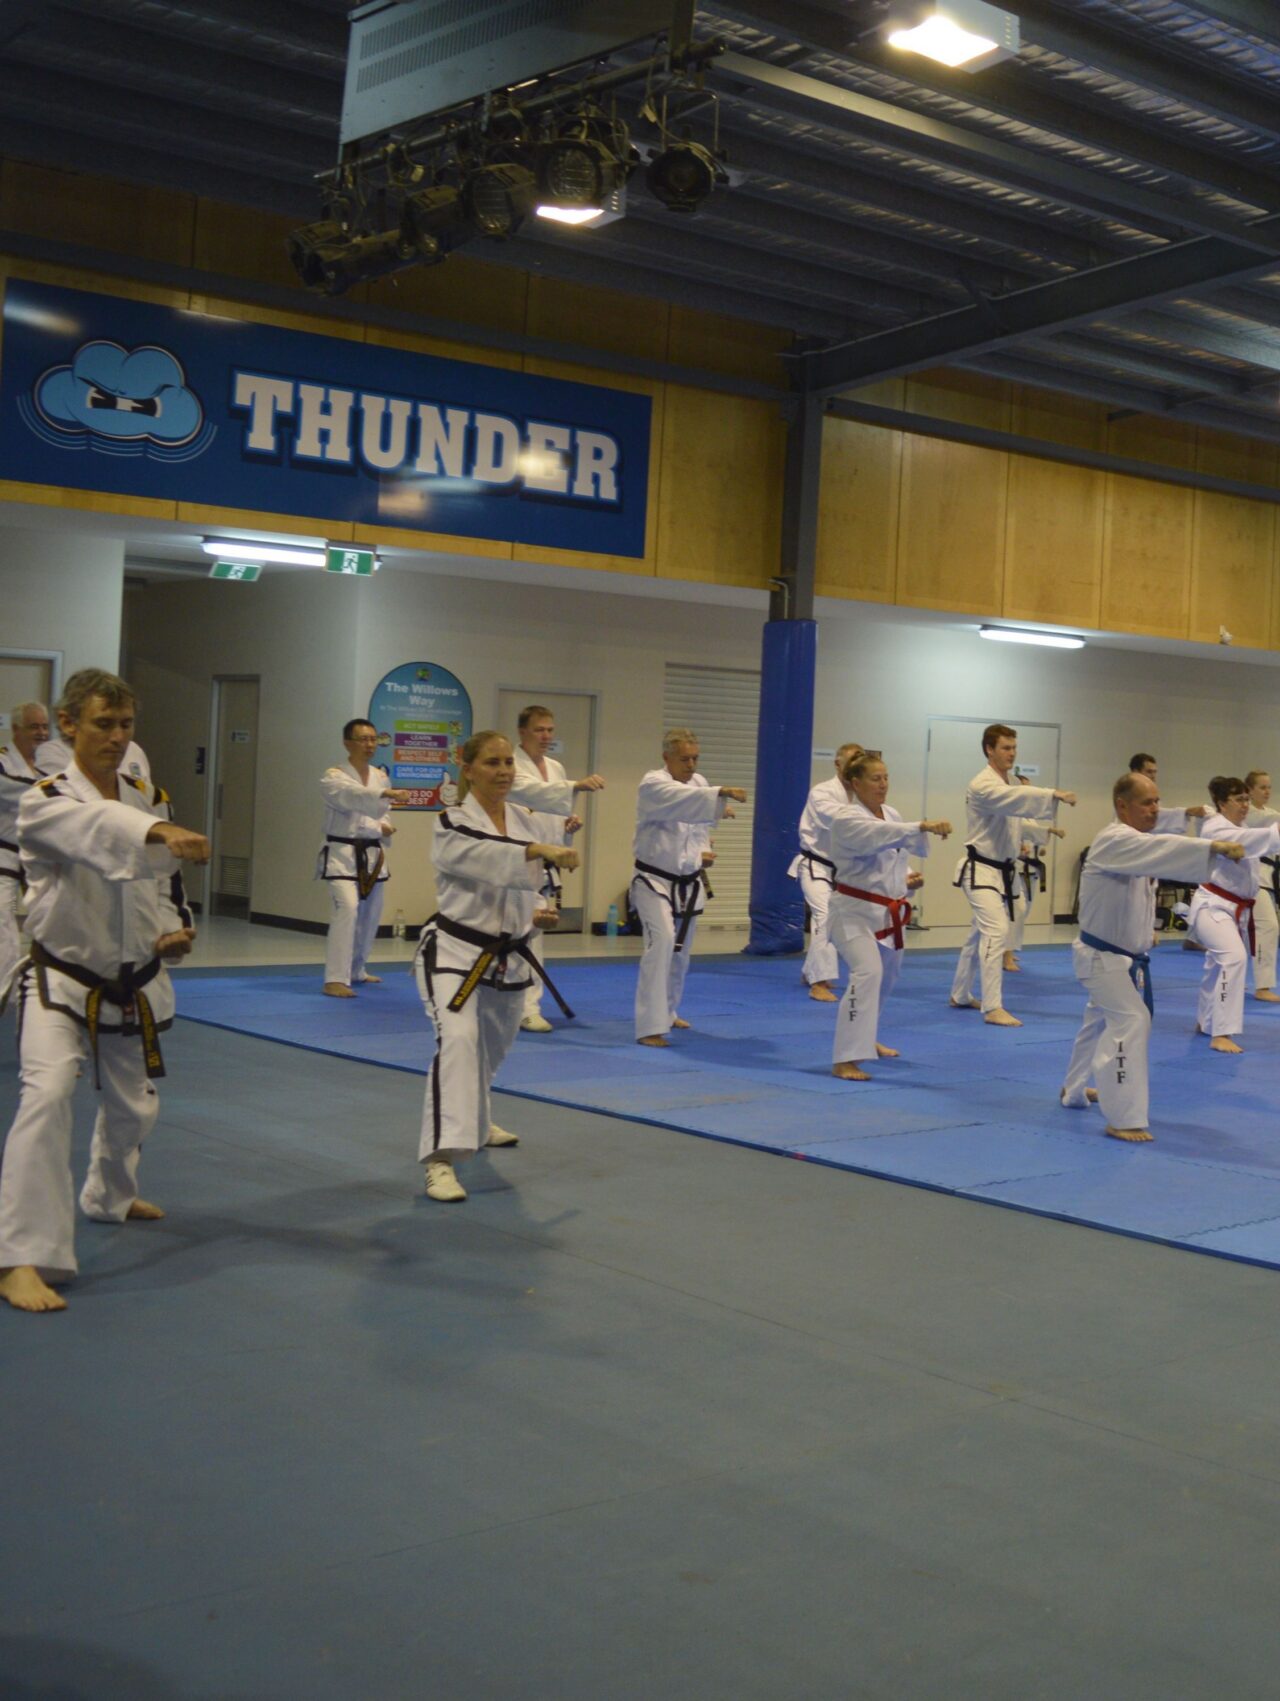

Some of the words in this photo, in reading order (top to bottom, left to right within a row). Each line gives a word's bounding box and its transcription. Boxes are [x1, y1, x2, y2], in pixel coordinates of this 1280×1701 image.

[233, 370, 620, 503] THUNDER
[385, 681, 409, 693] The
[411, 684, 459, 697] Willows
[409, 695, 436, 708] Way
[421, 790, 433, 798] DO
[848, 984, 857, 1022] ITF
[1115, 1041, 1126, 1084] ITF
